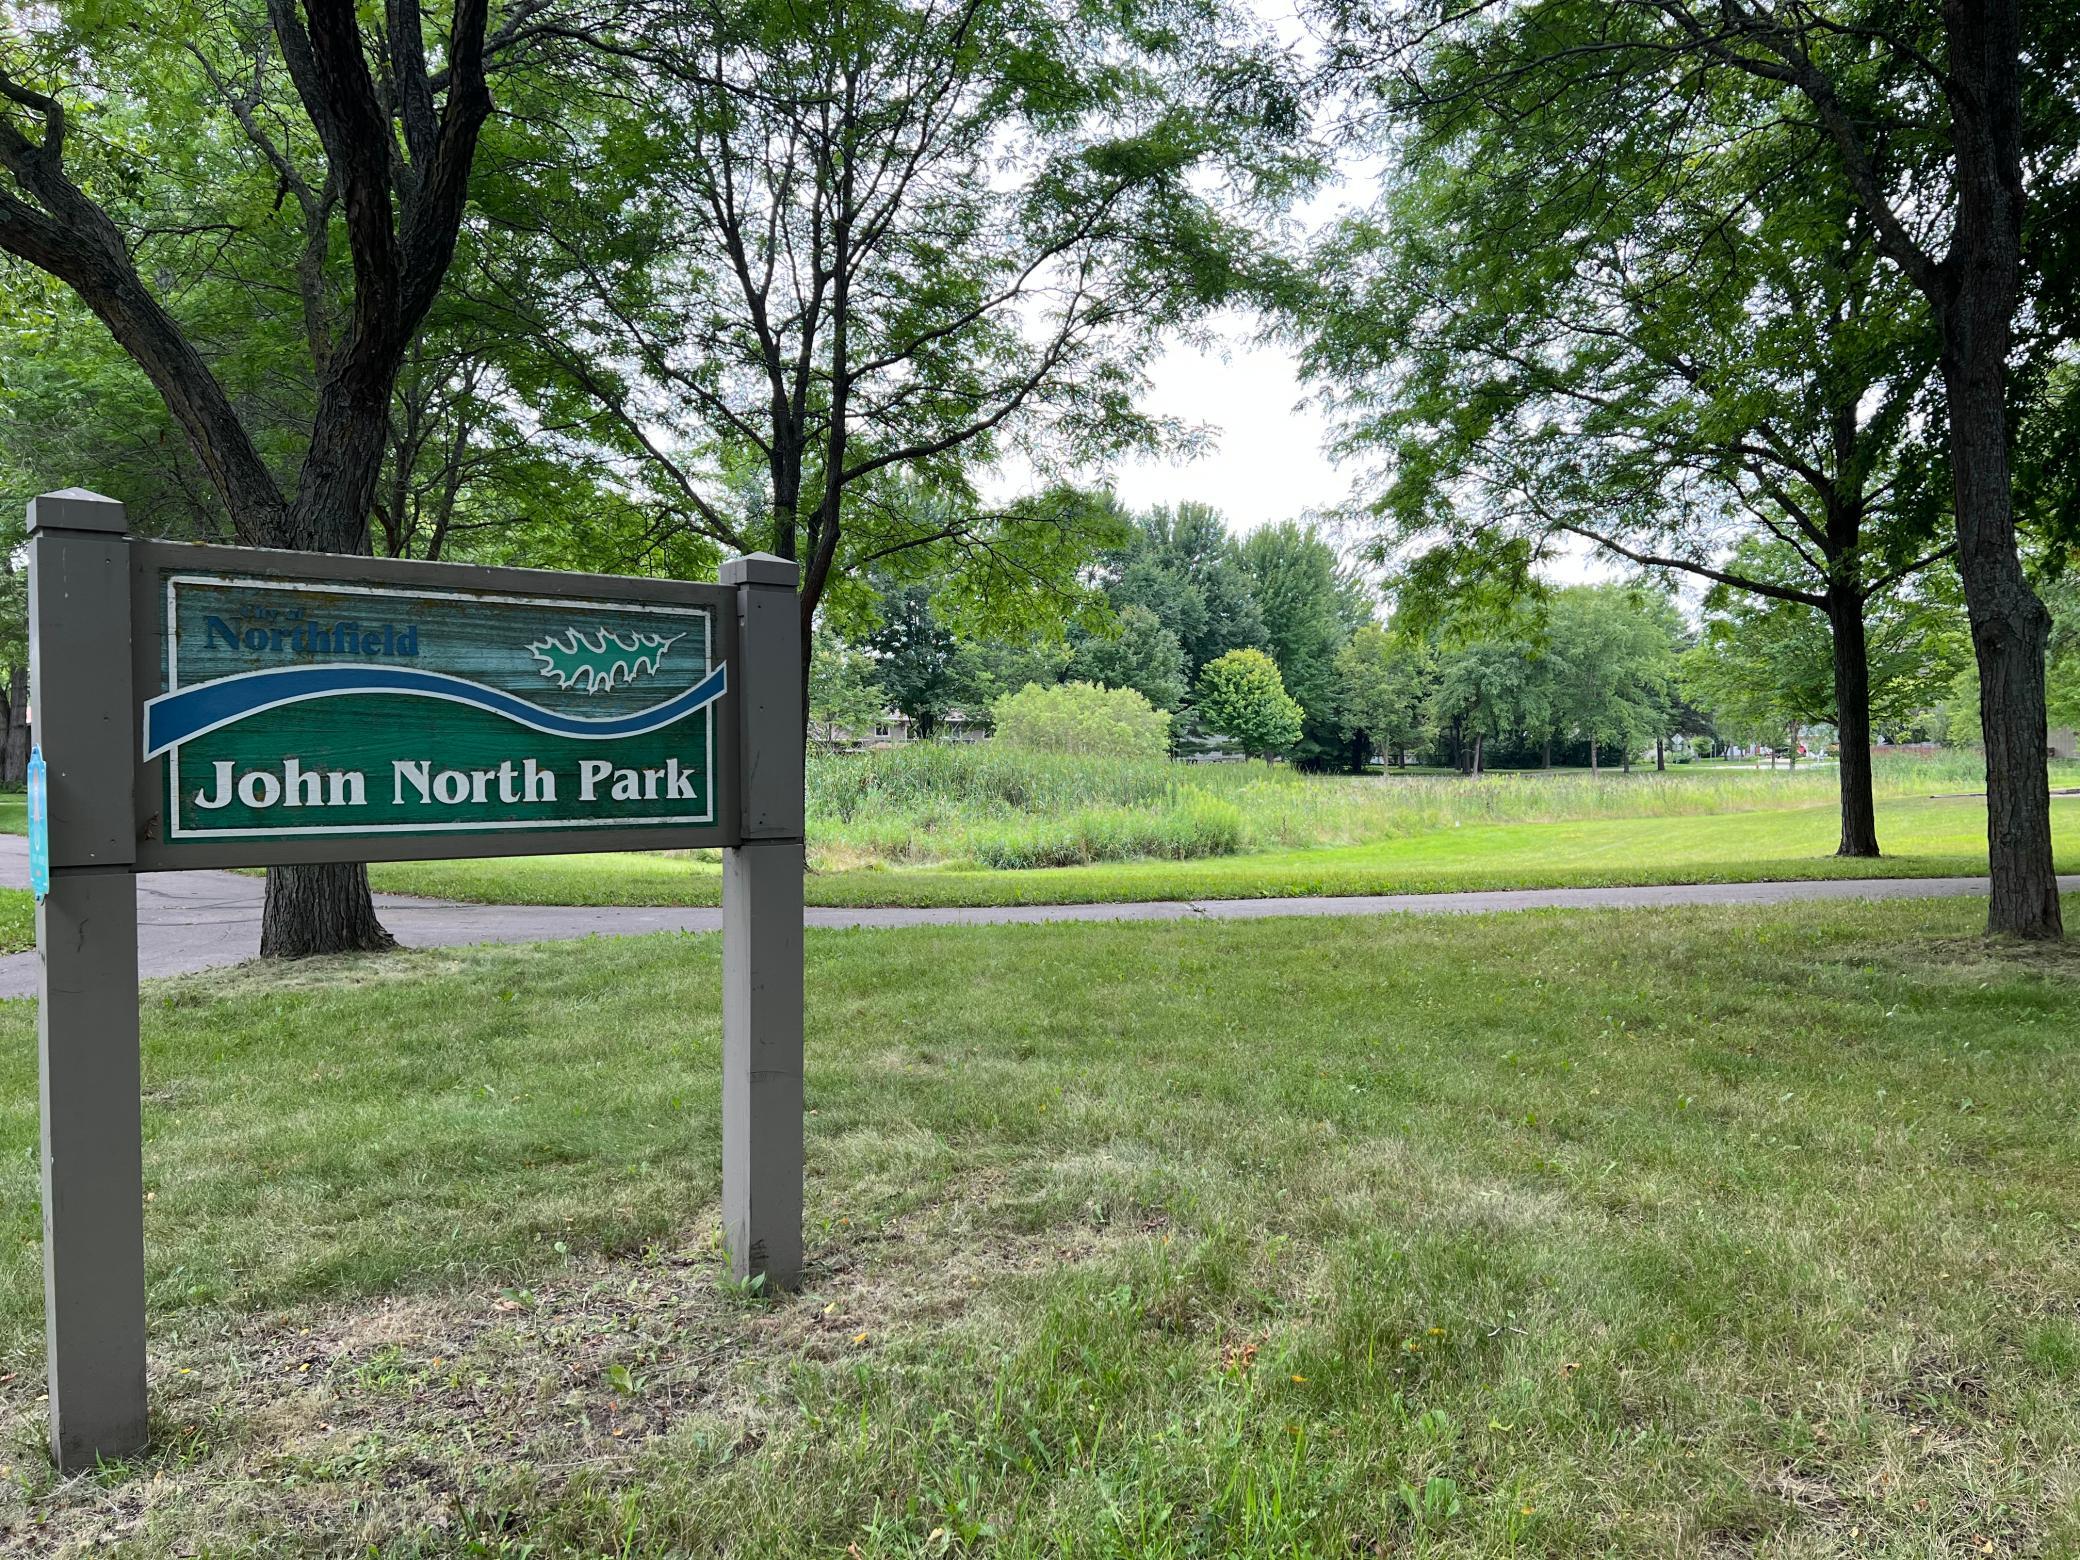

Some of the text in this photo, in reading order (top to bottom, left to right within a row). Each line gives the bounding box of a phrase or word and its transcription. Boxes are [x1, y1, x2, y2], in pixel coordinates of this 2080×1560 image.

[203, 615, 419, 656] Northfield
[194, 758, 698, 809] John North Park
